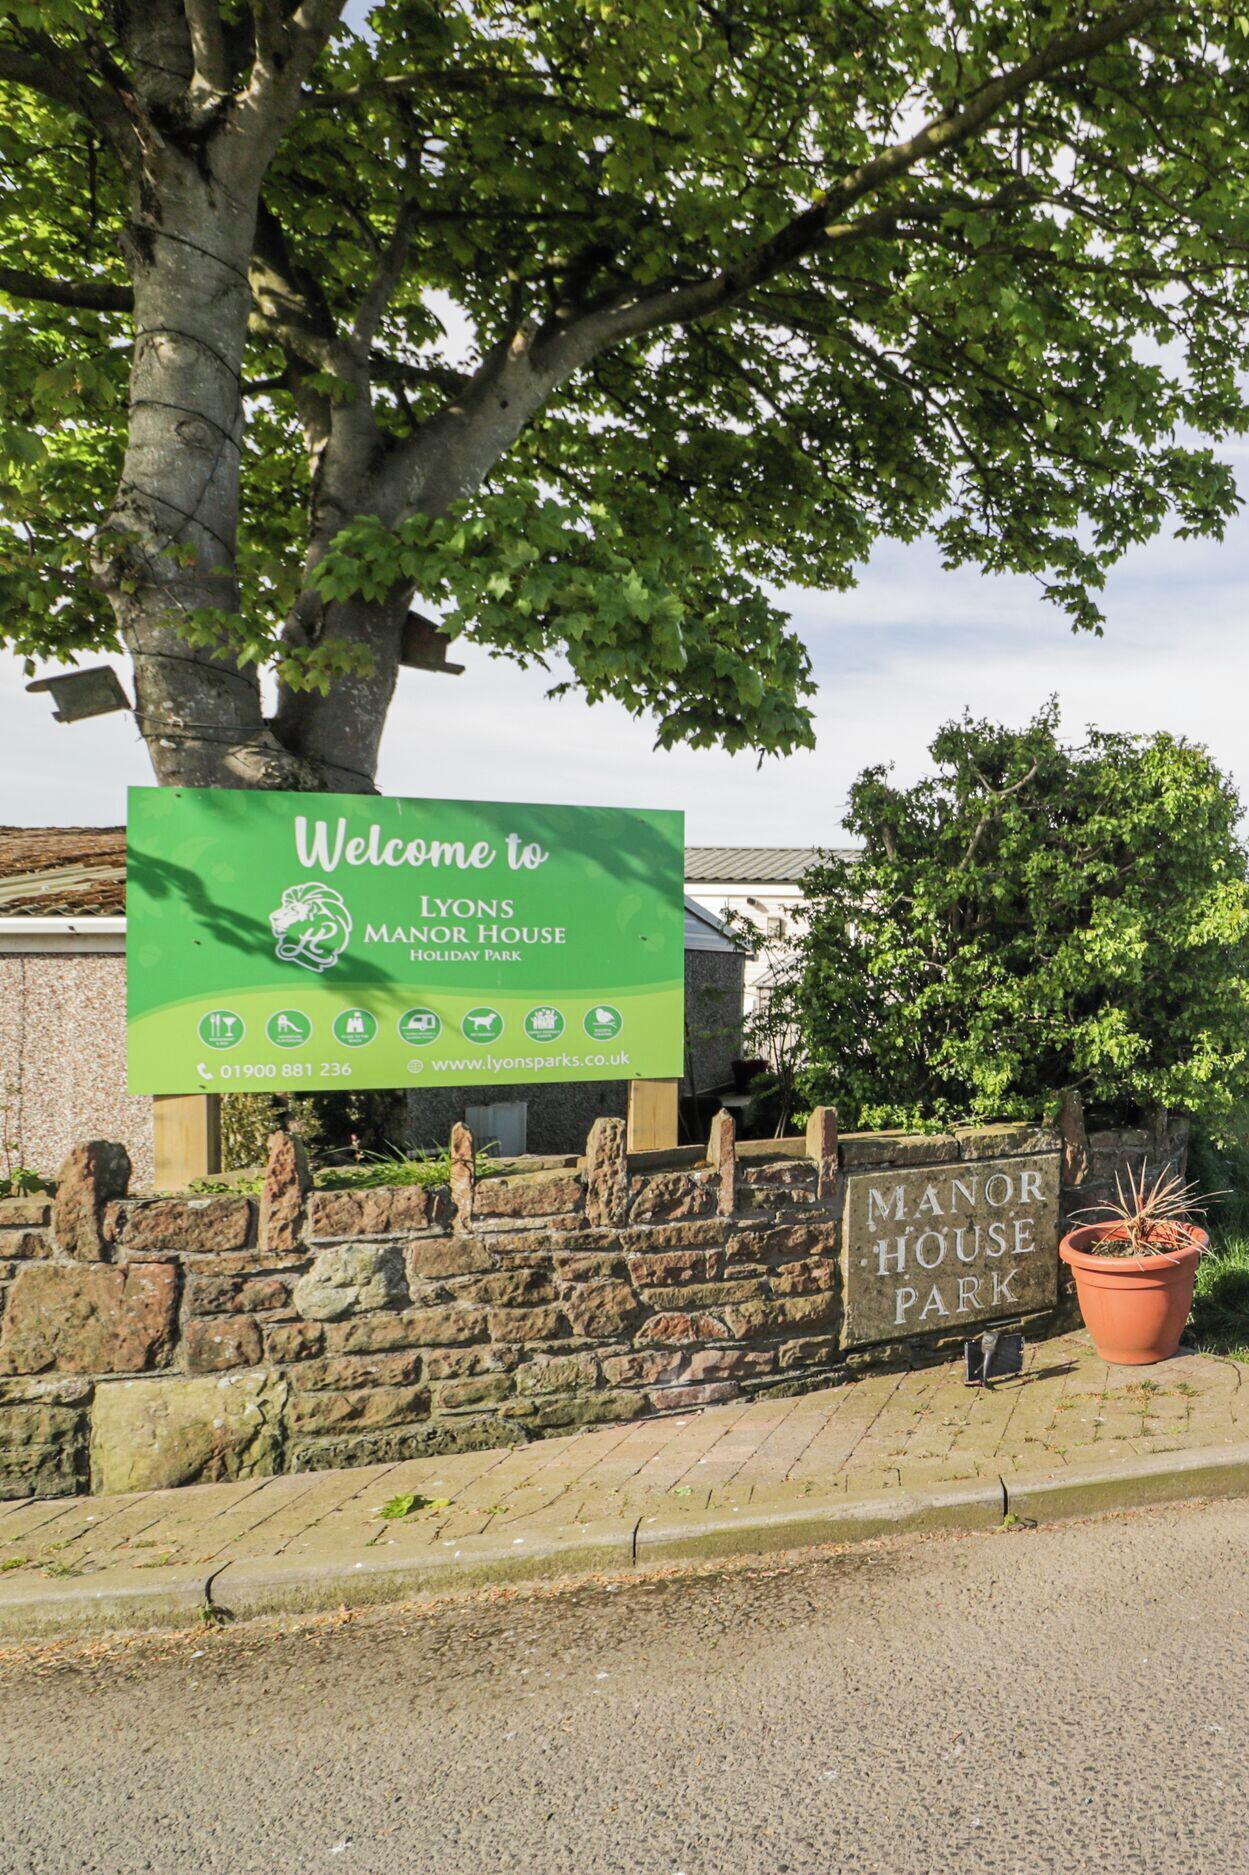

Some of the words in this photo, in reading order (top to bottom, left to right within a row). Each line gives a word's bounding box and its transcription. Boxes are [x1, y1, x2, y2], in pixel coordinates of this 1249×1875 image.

[294, 816, 497, 873] Welcome
[505, 833, 549, 870] to
[419, 895, 514, 918] LYONS
[363, 923, 470, 944] MANOR
[477, 924, 566, 944] HOUSE
[409, 950, 481, 962] HOLIDAY
[484, 949, 522, 961] PARK
[220, 1063, 277, 1079] 01900
[281, 1063, 313, 1078] 881
[319, 1062, 352, 1077] 236
[431, 1051, 630, 1073] www.lyonsparks.co.uk
[865, 1171, 1047, 1225] MANOR
[875, 1218, 1036, 1276] HOUSE
[893, 1268, 1022, 1325] PARK
